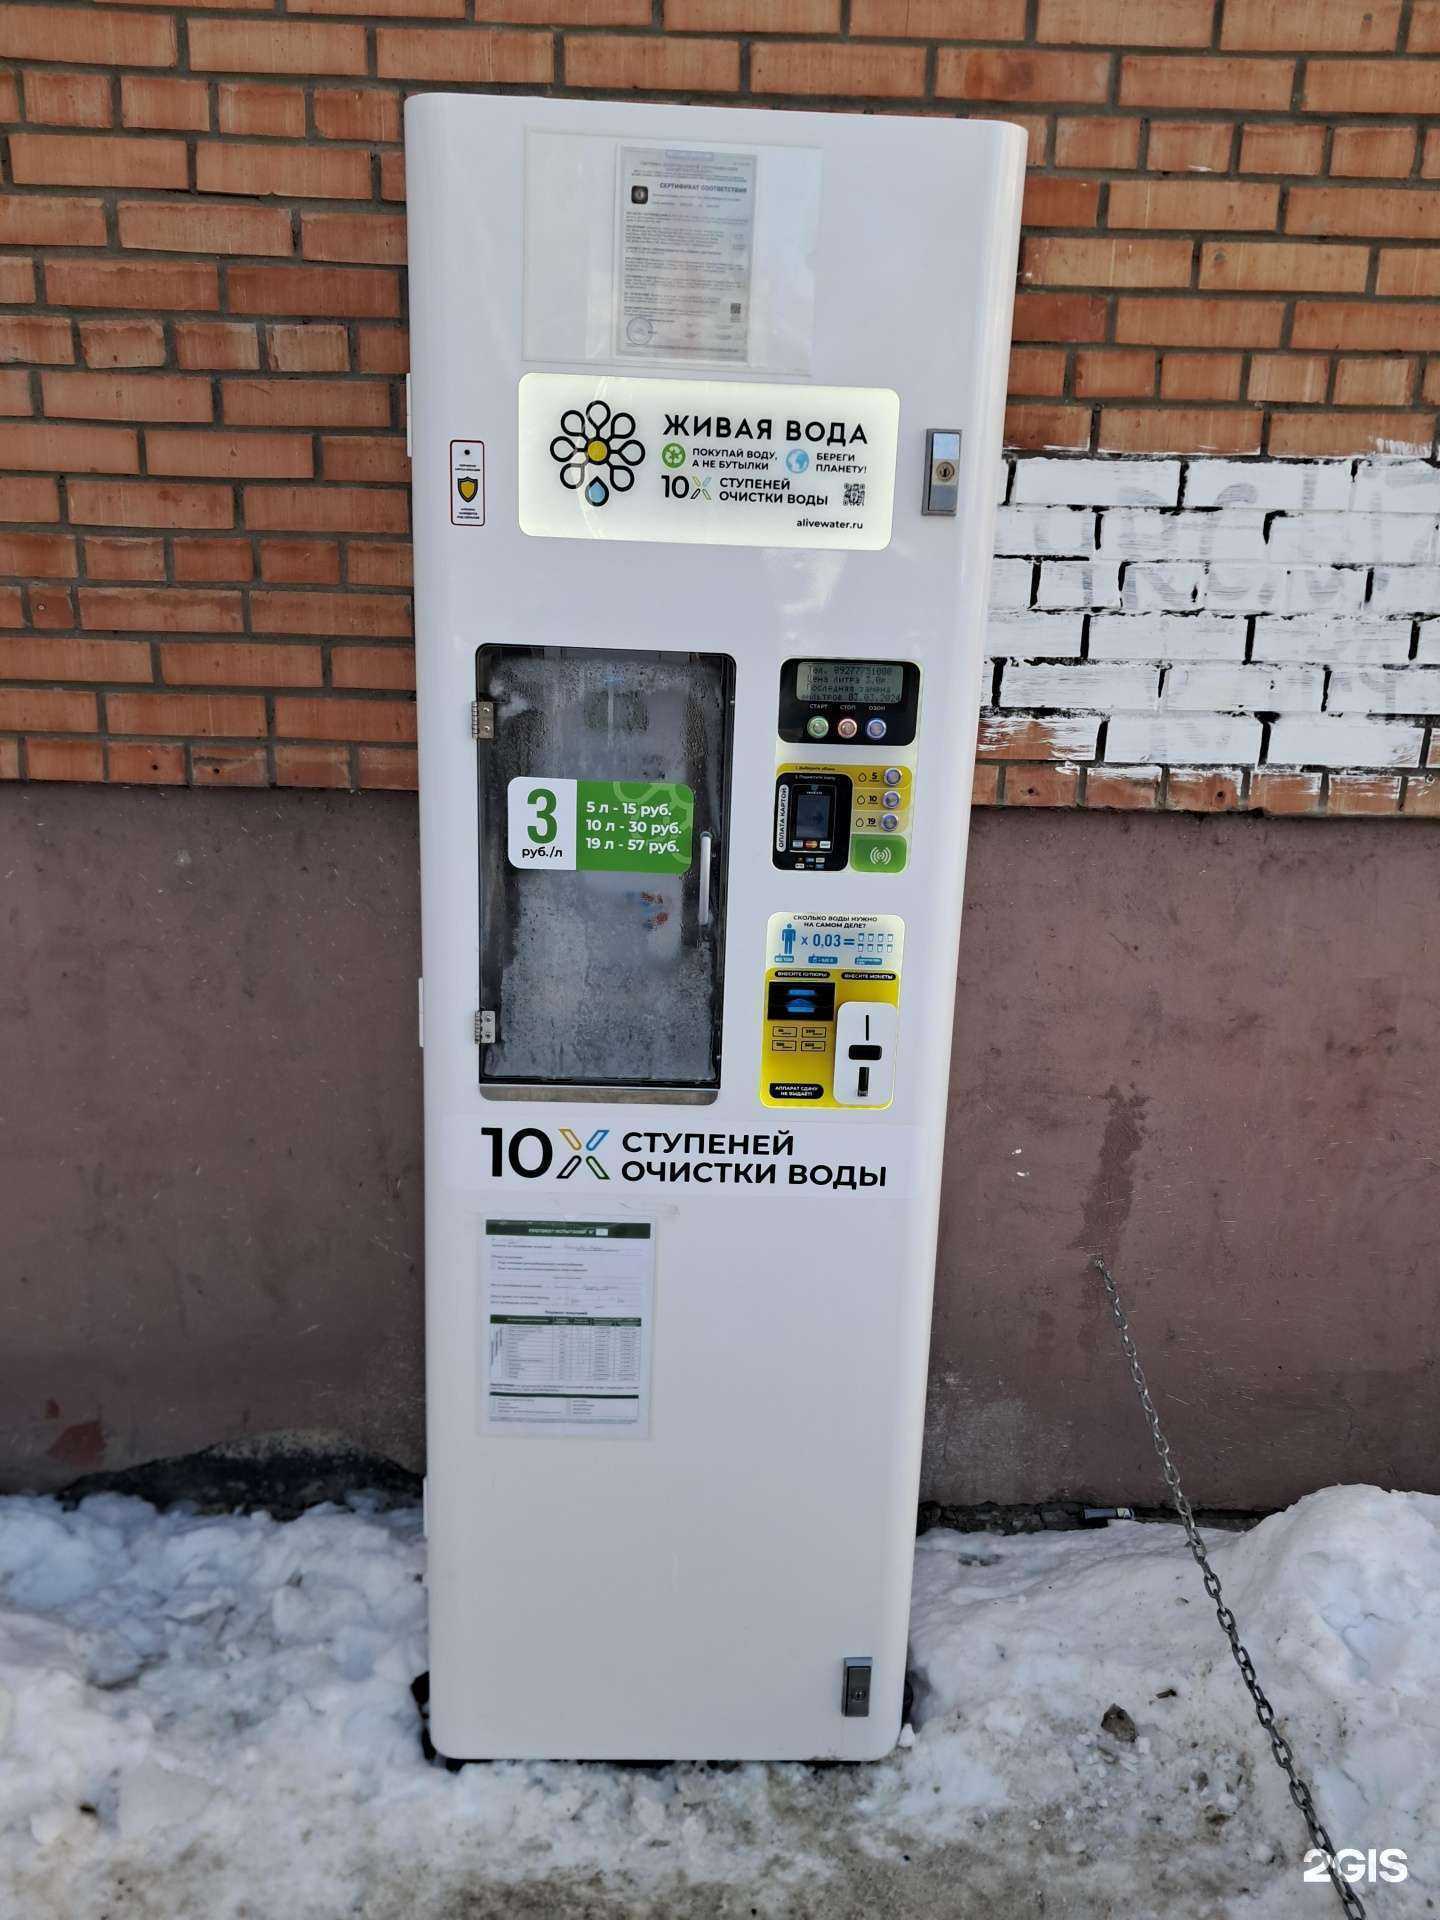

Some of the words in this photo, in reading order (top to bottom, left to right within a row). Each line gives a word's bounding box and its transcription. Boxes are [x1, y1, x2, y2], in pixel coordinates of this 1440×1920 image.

[663, 414, 772, 440] ЖИВАЯ
[786, 420, 868, 446] ВОДА
[692, 447, 744, 458] ПОКУПАЙ
[746, 450, 778, 460] ВОДУ,
[816, 452, 856, 462] БЕРЕГИ
[692, 460, 699, 468] А
[702, 460, 716, 469] НЕ
[719, 460, 769, 471] БУТЫЛКИ
[815, 464, 867, 474] ПЛАНЕТУ!
[719, 477, 791, 490] СТУПЕНЕЙ
[719, 490, 784, 504] ОЧИСТКИ
[787, 494, 829, 506] ВОДЫ
[796, 518, 864, 530] alivewater.ru
[780, 786, 788, 815] КАРТОЙ
[527, 788, 558, 844] 3
[586, 801, 595, 813] 5
[599, 804, 609, 814] л
[623, 802, 637, 814] 15
[640, 803, 672, 818] руб.
[586, 819, 601, 832] 10
[605, 822, 615, 832] л
[628, 821, 647, 833] 30
[651, 821, 682, 836] руб.
[867, 817, 876, 825] 19
[778, 819, 786, 848] ОПЛАТА
[522, 846, 563, 859] руб./л
[586, 837, 601, 850] 19
[604, 840, 614, 850] л
[627, 839, 645, 851] 57
[648, 840, 680, 854] руб.
[813, 934, 841, 948] 0,03
[622, 1130, 795, 1156] СТУПЕНЕЙ
[621, 1160, 776, 1184] ОЧИСТКИ
[788, 1163, 887, 1190] ВОДЫ
